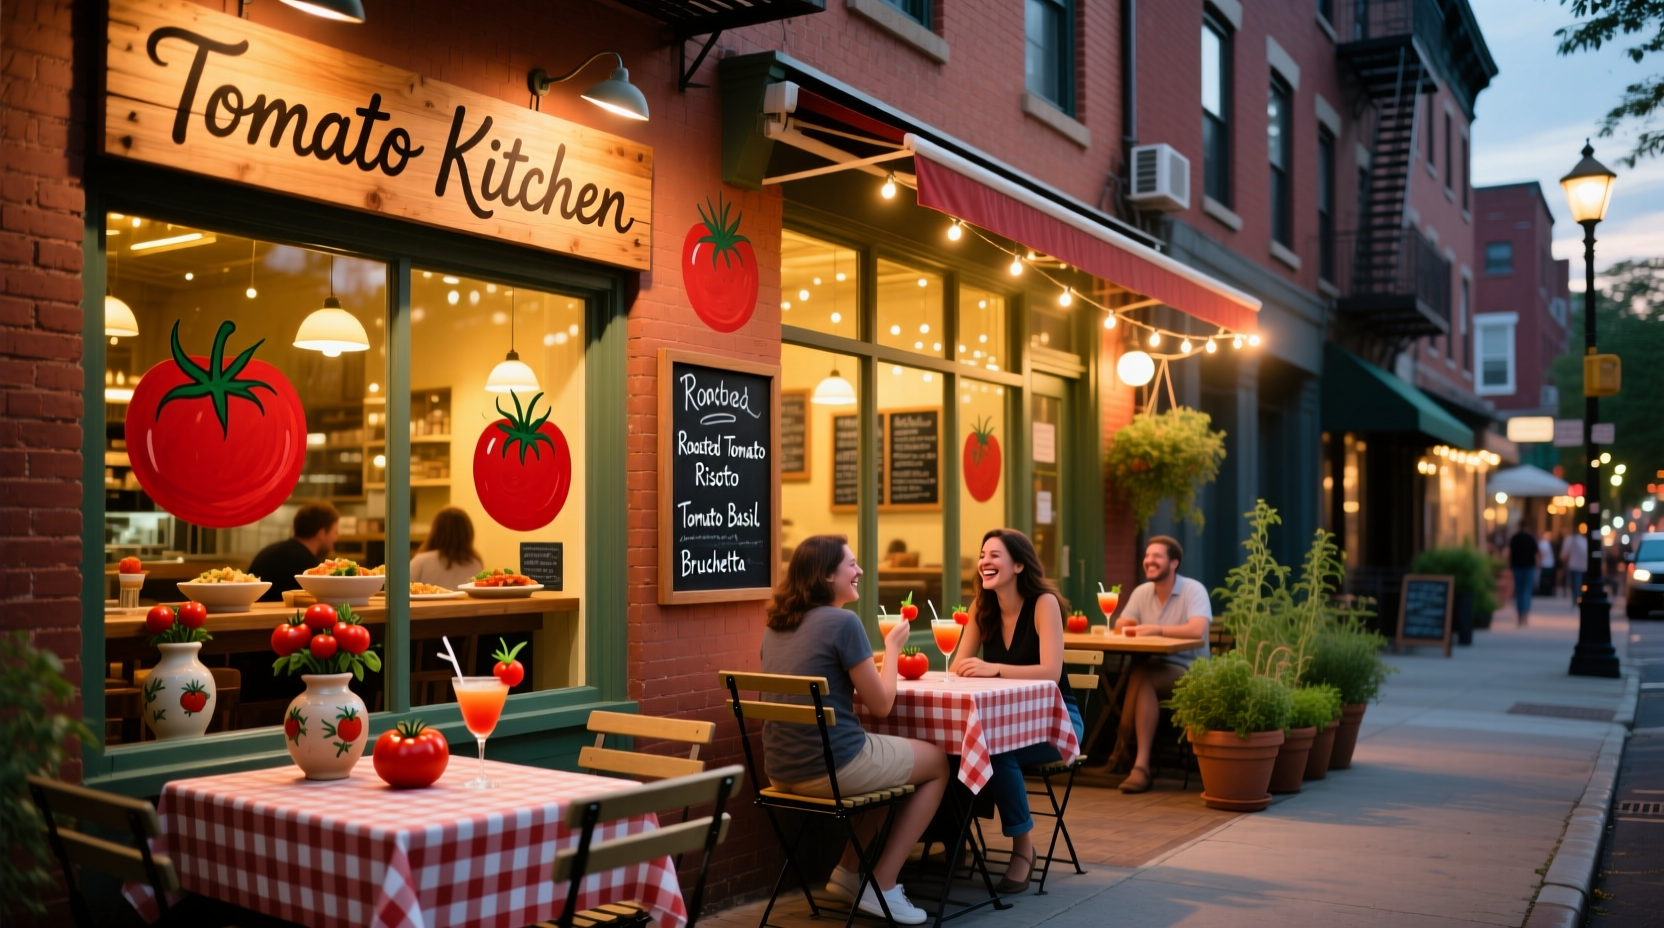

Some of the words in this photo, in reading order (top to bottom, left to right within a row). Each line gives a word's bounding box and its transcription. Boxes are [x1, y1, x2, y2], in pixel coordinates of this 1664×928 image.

[146, 27, 424, 177] Tomato
[435, 105, 634, 234] Kitchen
[695, 462, 740, 487] Risoto
[727, 501, 760, 528] Basil
